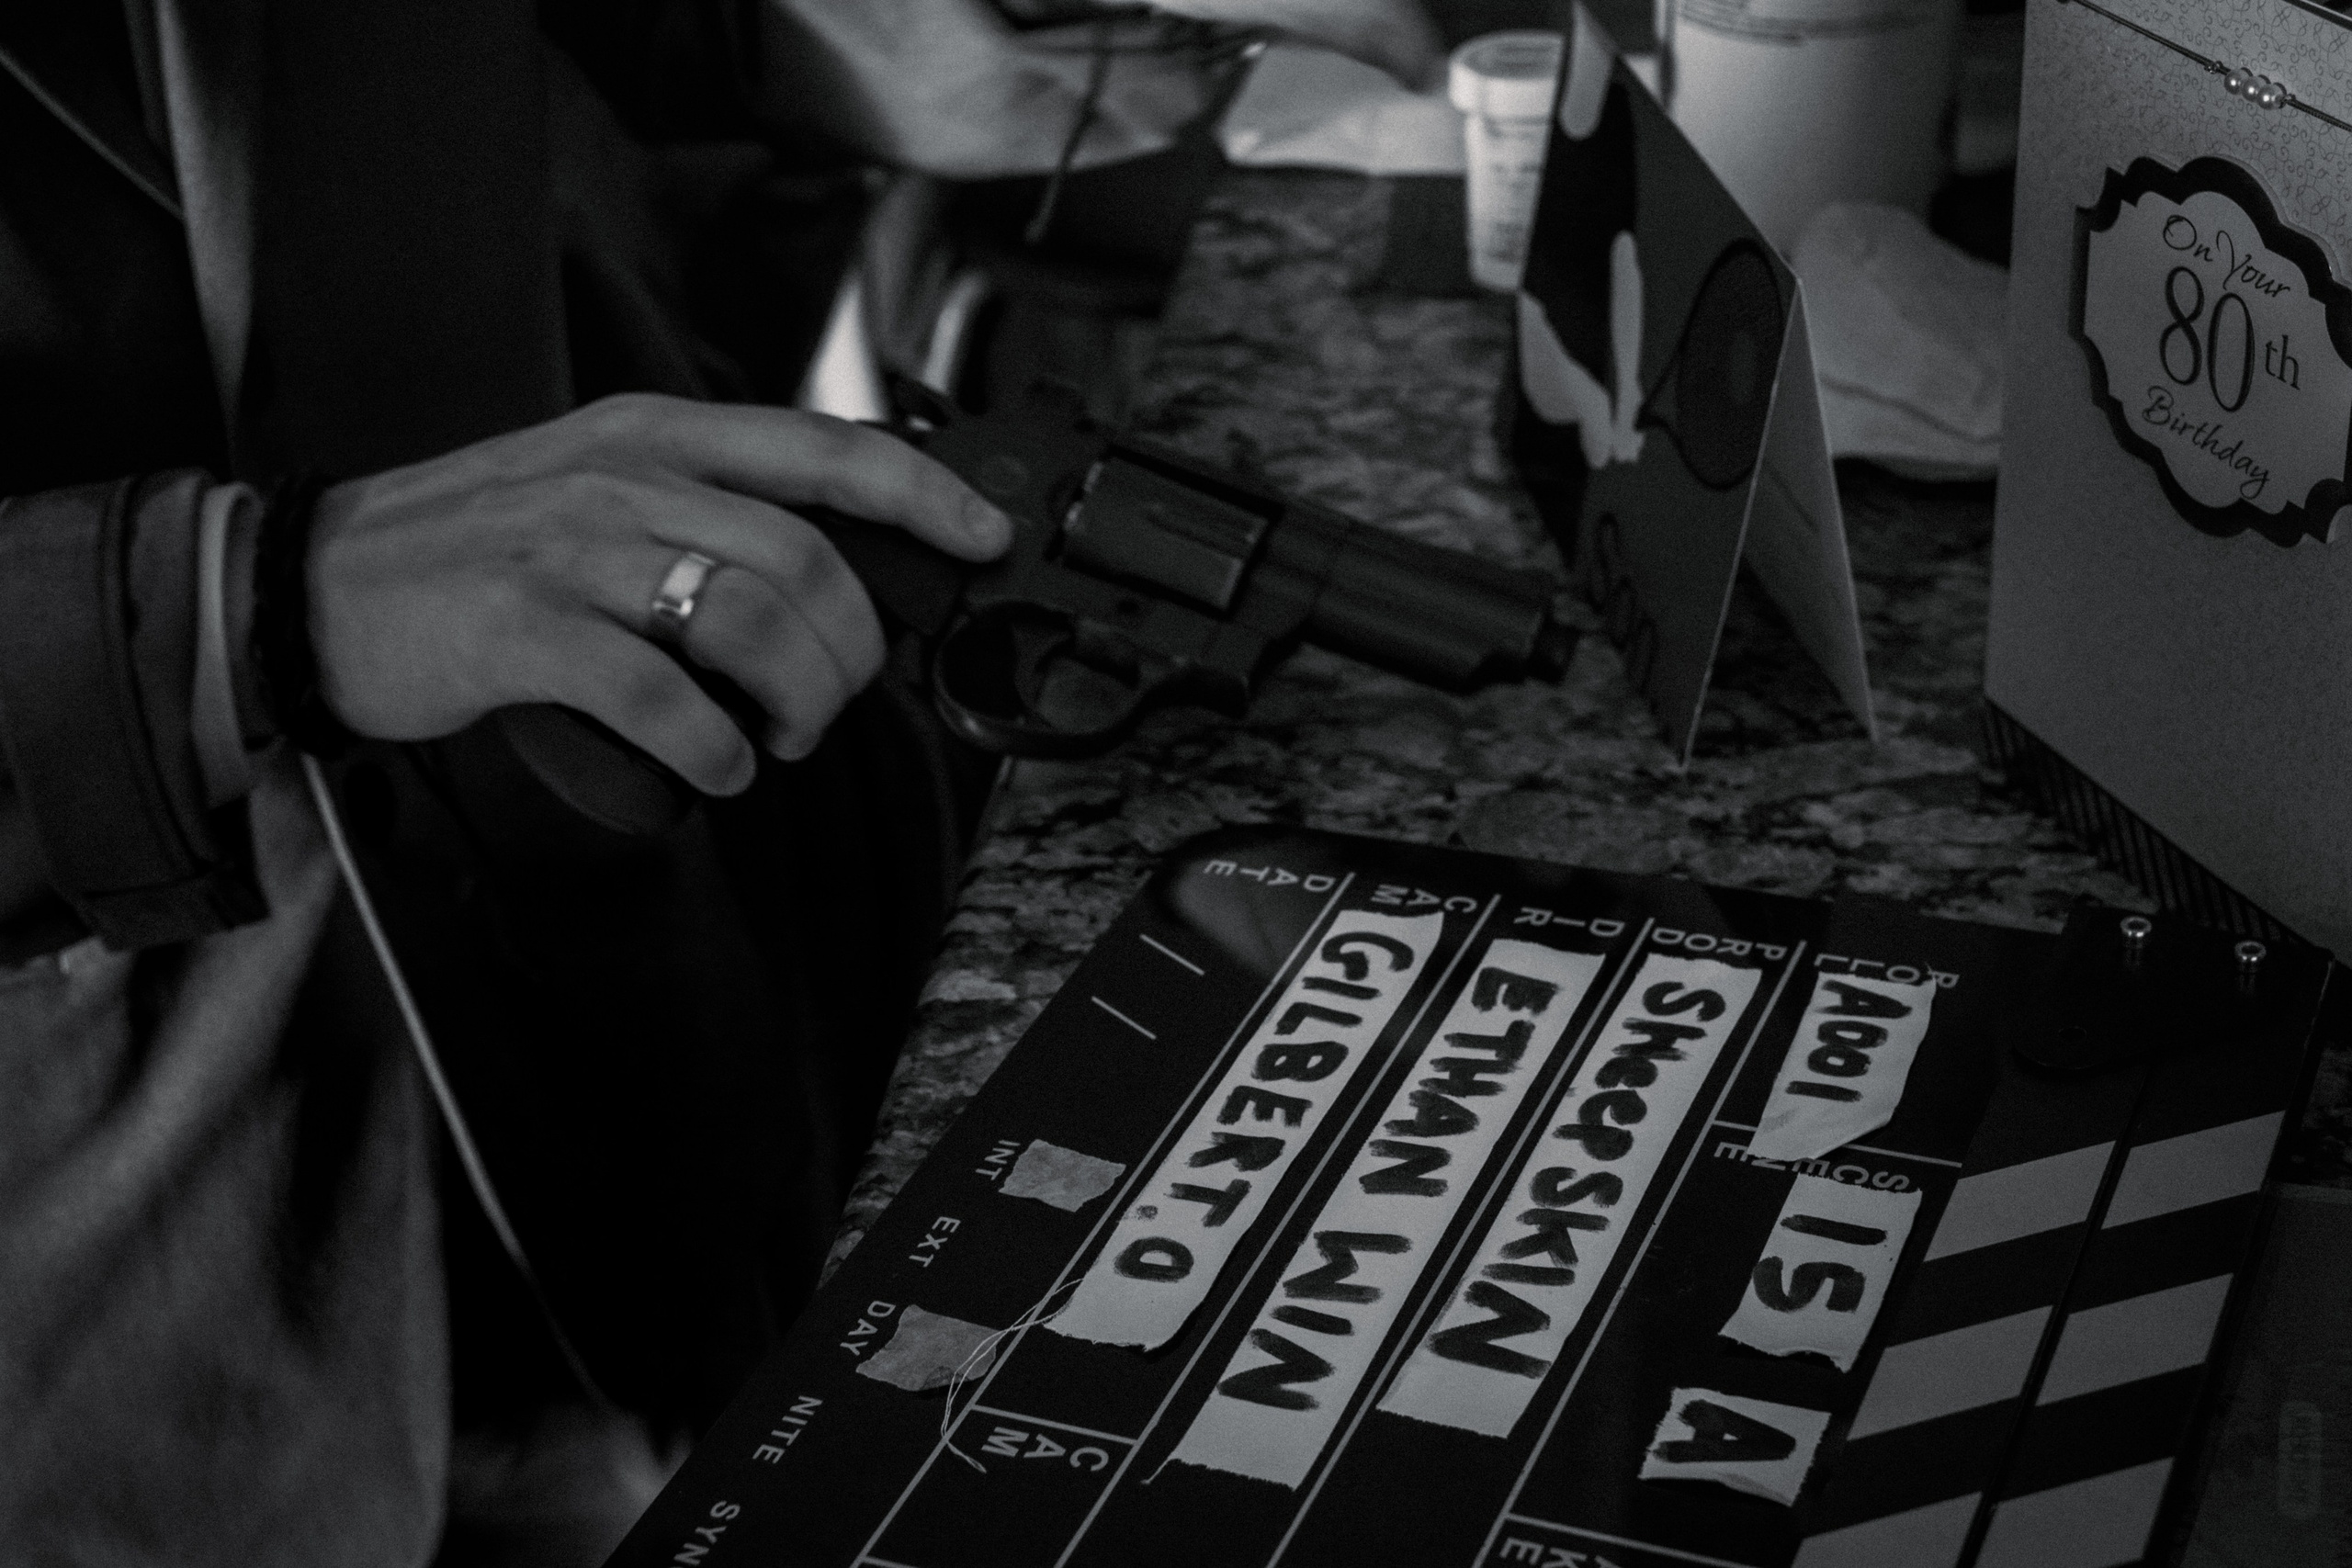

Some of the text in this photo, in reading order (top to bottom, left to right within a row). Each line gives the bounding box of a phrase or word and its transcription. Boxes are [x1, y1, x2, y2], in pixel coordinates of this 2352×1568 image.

[2163, 214, 2291, 298] On Your
[2141, 385, 2270, 500] Birthday
[1204, 859, 1338, 893] DATE
[1370, 883, 1478, 914] CAM
[1512, 906, 1625, 939] DIR
[1650, 926, 1789, 962] PROD
[1813, 953, 1961, 990] ROLL
[1784, 979, 1913, 1102] A001
[1217, 965, 1561, 1411] ETHAN WIN
[668, 1139, 1022, 1568] INT EXT DAY NITE SYN
[980, 1425, 1110, 1472] CAM
[1651, 1399, 1796, 1463] A
